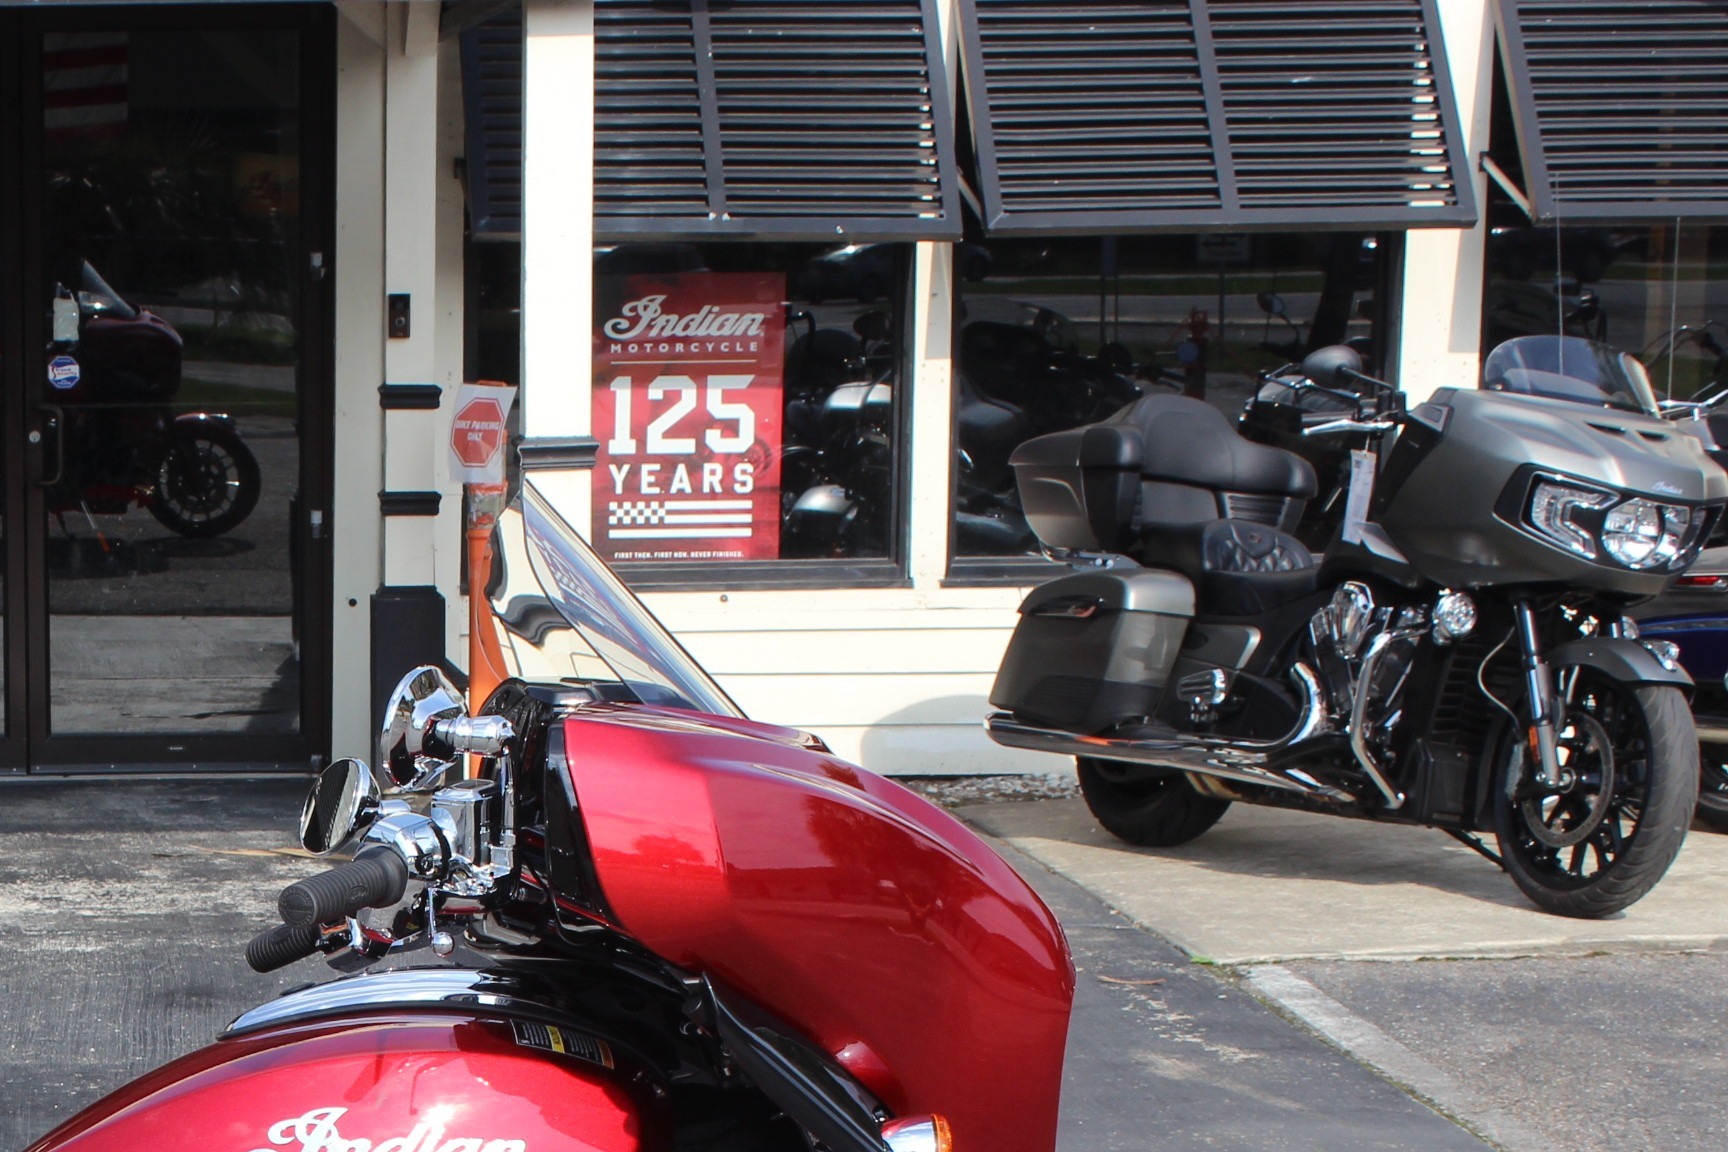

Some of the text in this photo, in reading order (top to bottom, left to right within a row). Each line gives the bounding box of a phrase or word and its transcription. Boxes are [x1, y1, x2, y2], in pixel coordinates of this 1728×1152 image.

[604, 294, 764, 341] Indian
[610, 342, 758, 354] MOTORCYCLE
[608, 374, 756, 455] 125
[471, 421, 500, 430] PARKING
[467, 432, 483, 442] ONLY
[608, 462, 755, 495] YEARS
[614, 551, 633, 559] FIRST
[690, 550, 711, 558] NEVER
